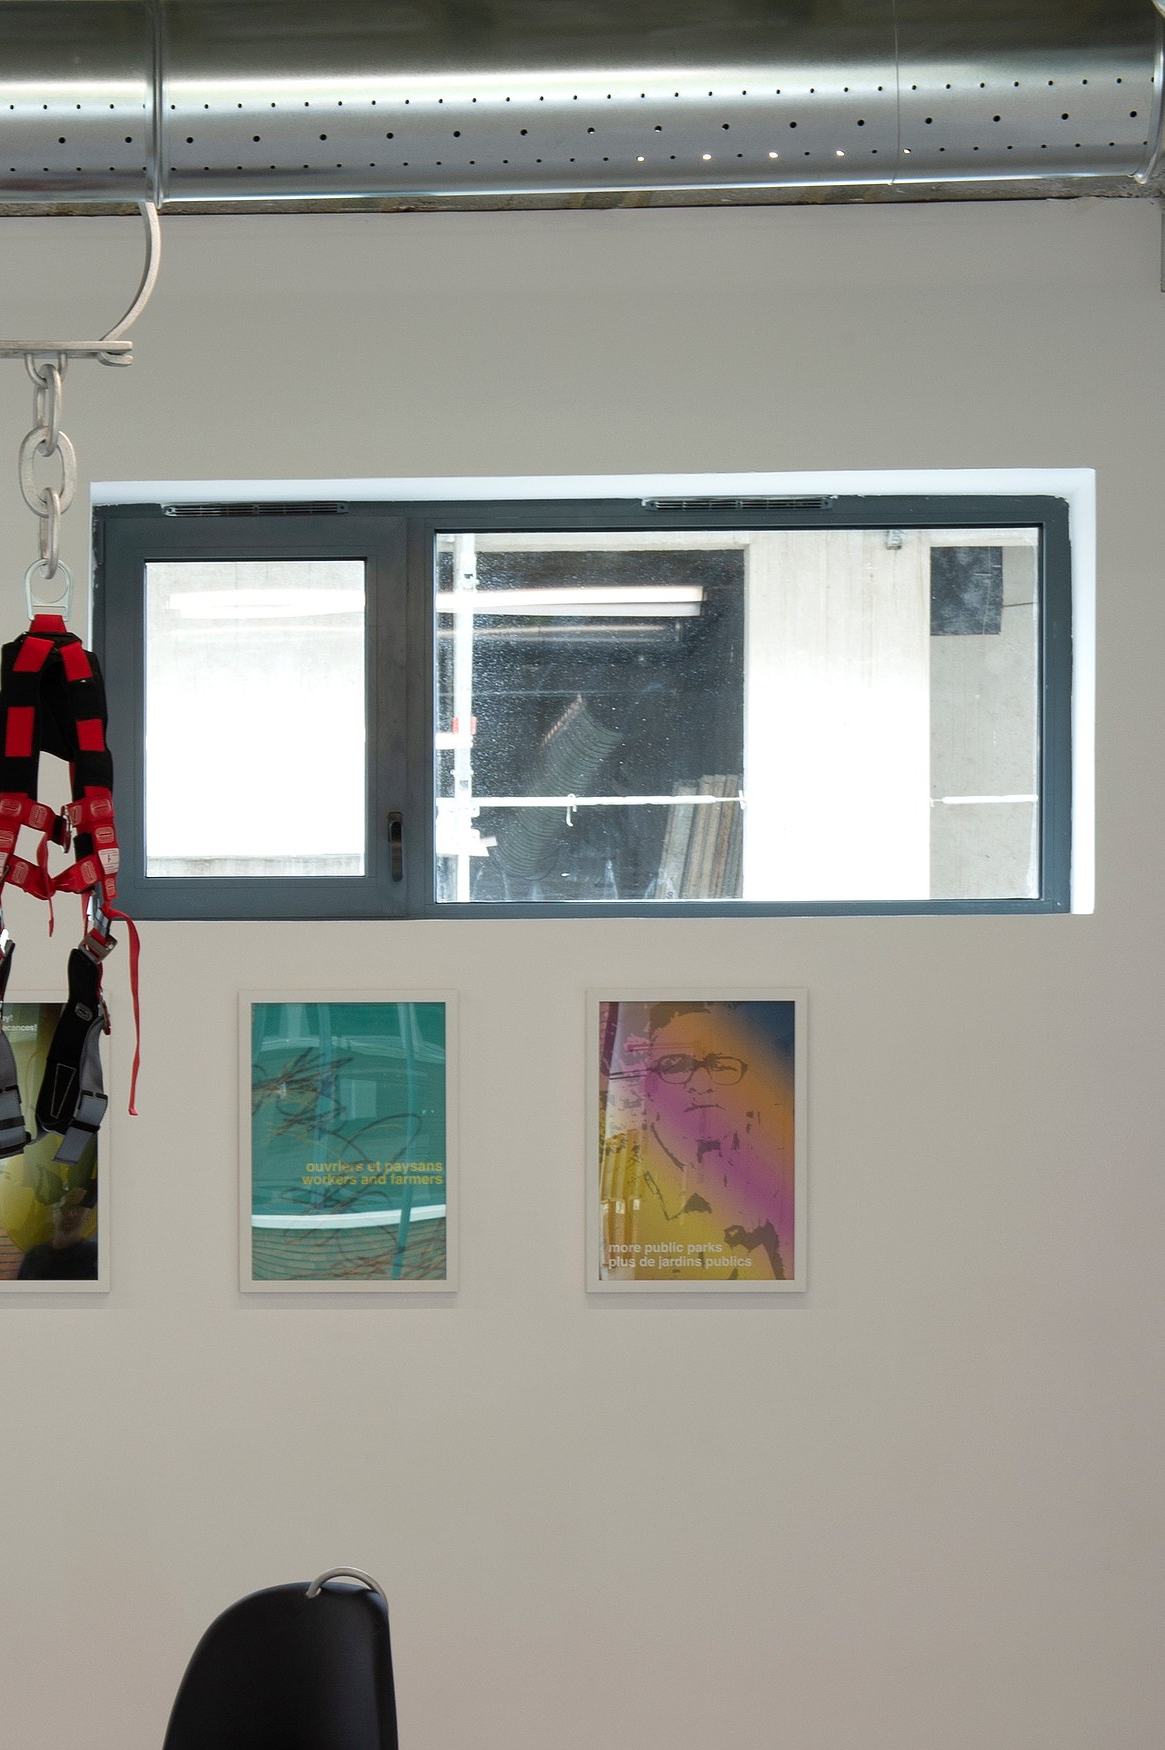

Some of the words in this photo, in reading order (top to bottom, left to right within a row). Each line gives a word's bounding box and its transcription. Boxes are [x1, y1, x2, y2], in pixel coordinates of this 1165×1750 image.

[306, 1160, 364, 1172] ouvriers
[367, 1160, 381, 1172] et
[384, 1161, 443, 1174] paysans
[301, 1174, 357, 1185] workers
[361, 1174, 387, 1185] and
[391, 1174, 443, 1185] farmers
[608, 1243, 642, 1253] more
[644, 1242, 684, 1255] public
[687, 1242, 723, 1255] parks
[608, 1256, 636, 1269] plus
[639, 1256, 655, 1267] de
[658, 1256, 702, 1269] jardins
[705, 1256, 753, 1269] publics
